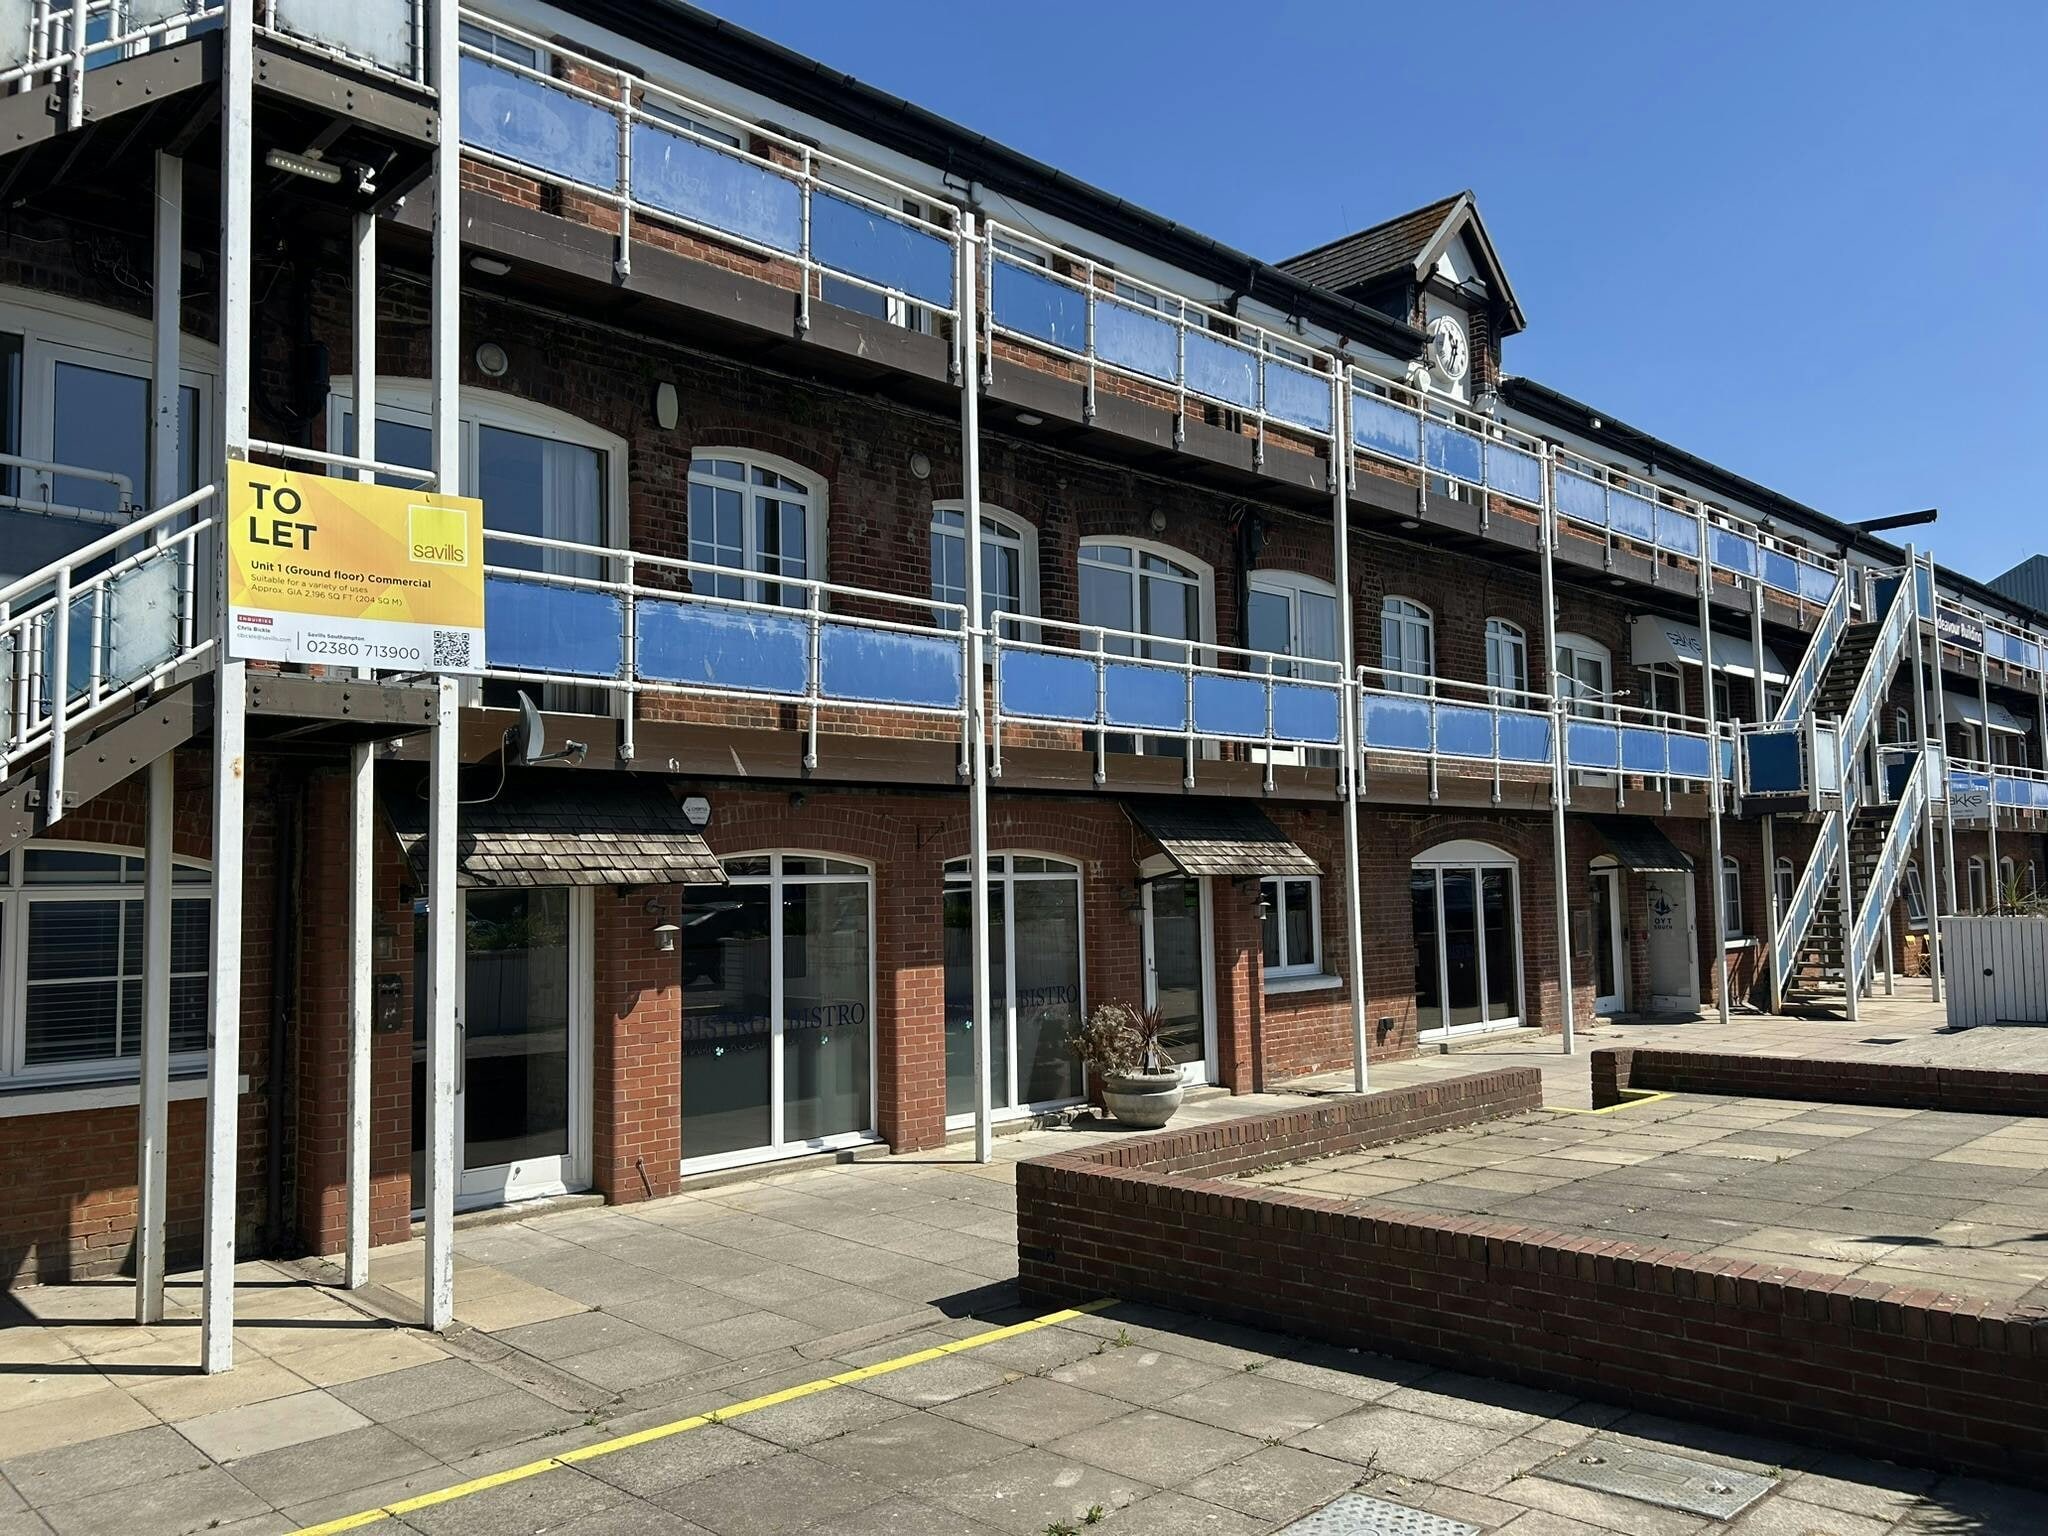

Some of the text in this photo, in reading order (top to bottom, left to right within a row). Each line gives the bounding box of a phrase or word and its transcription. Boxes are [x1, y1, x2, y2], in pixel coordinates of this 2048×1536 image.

[249, 481, 302, 514] TO
[250, 516, 317, 550] LET
[413, 543, 464, 562] savills
[251, 560, 431, 588] Unit 1 (Ground floor) Commercial
[251, 574, 285, 584] Suitable
[287, 578, 300, 586] for
[308, 581, 337, 591] variety
[251, 583, 283, 594] Approx.
[287, 588, 302, 596] GIA
[328, 592, 341, 600] SQ
[355, 595, 375, 604] (204
[377, 597, 390, 605] SQ
[391, 598, 403, 607] M)
[327, 633, 365, 641] Southampton
[307, 640, 420, 660] 02380 713900
[1020, 984, 1078, 1008] BISTRO
[789, 1003, 865, 1030] BISTRO
